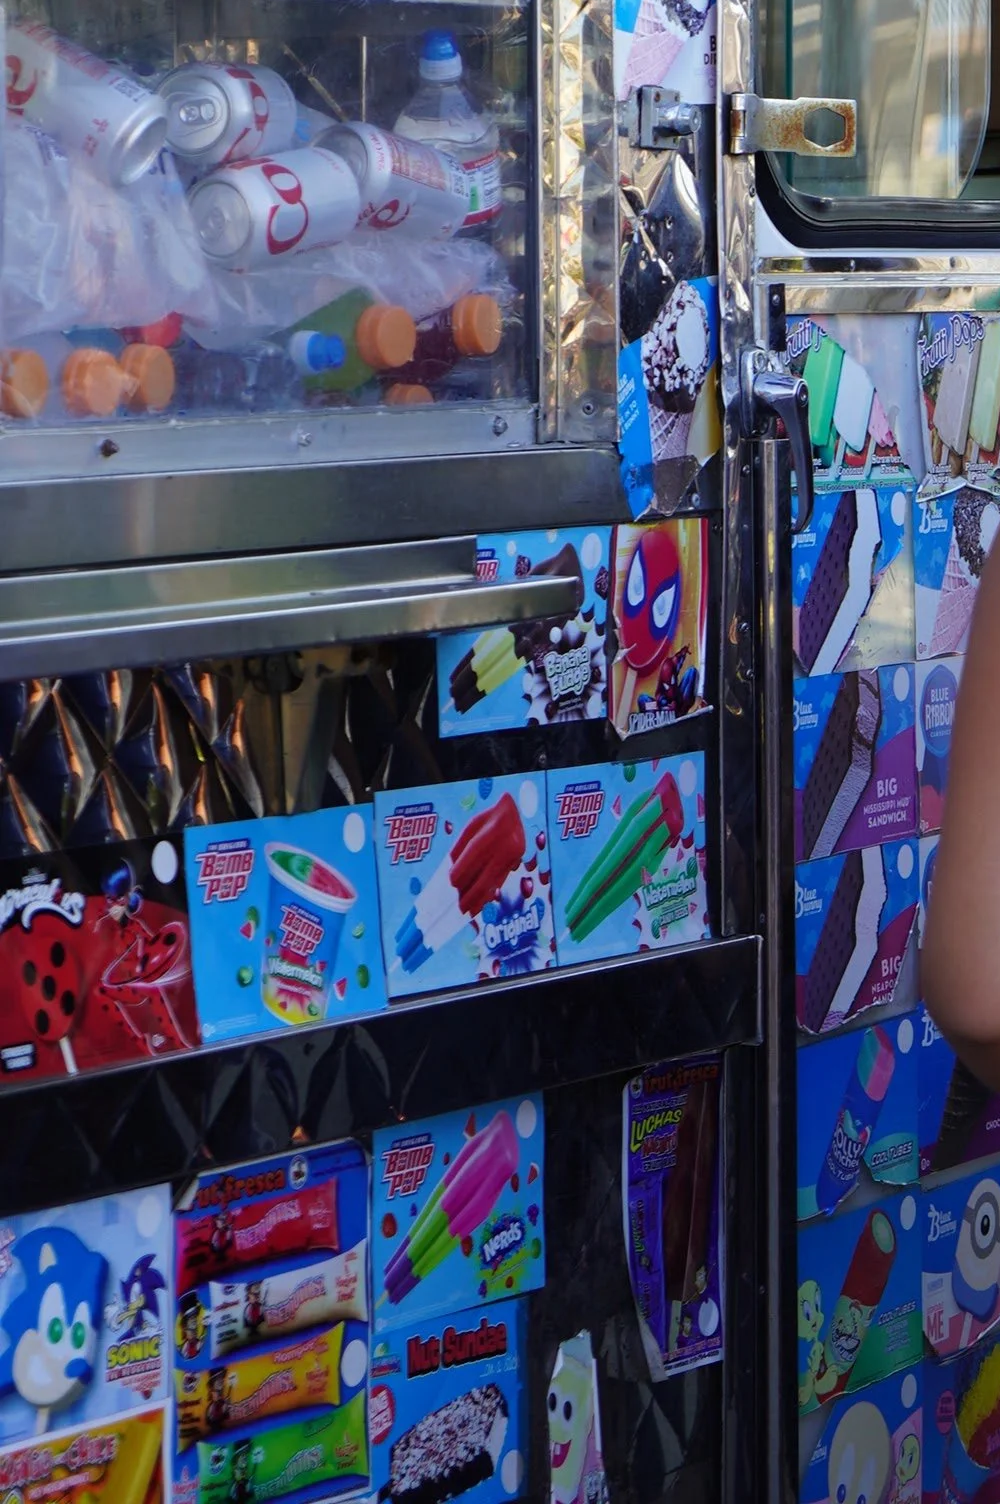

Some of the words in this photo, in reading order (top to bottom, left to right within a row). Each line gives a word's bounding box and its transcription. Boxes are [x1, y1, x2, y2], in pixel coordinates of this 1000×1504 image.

[543, 645, 592, 678] Banana
[549, 663, 592, 701] Fudge
[930, 687, 949, 702] BLUE
[876, 777, 898, 798] BIG
[556, 792, 604, 817] BOMB
[867, 811, 907, 828] SANDWICH
[386, 814, 437, 840] BOMB
[560, 814, 600, 840] POP
[197, 850, 254, 879] BOMB
[388, 837, 431, 864] POP
[200, 874, 247, 904] POP
[282, 907, 324, 943] BOMB
[484, 903, 540, 949] Original
[281, 926, 317, 957] POP
[383, 1144, 434, 1176] BOMB
[385, 1167, 425, 1199] POP
[926, 1314, 945, 1343] ME
[106, 1337, 161, 1370] SONIC
[407, 1334, 441, 1380] Nut
[442, 1317, 508, 1369] Sundae
